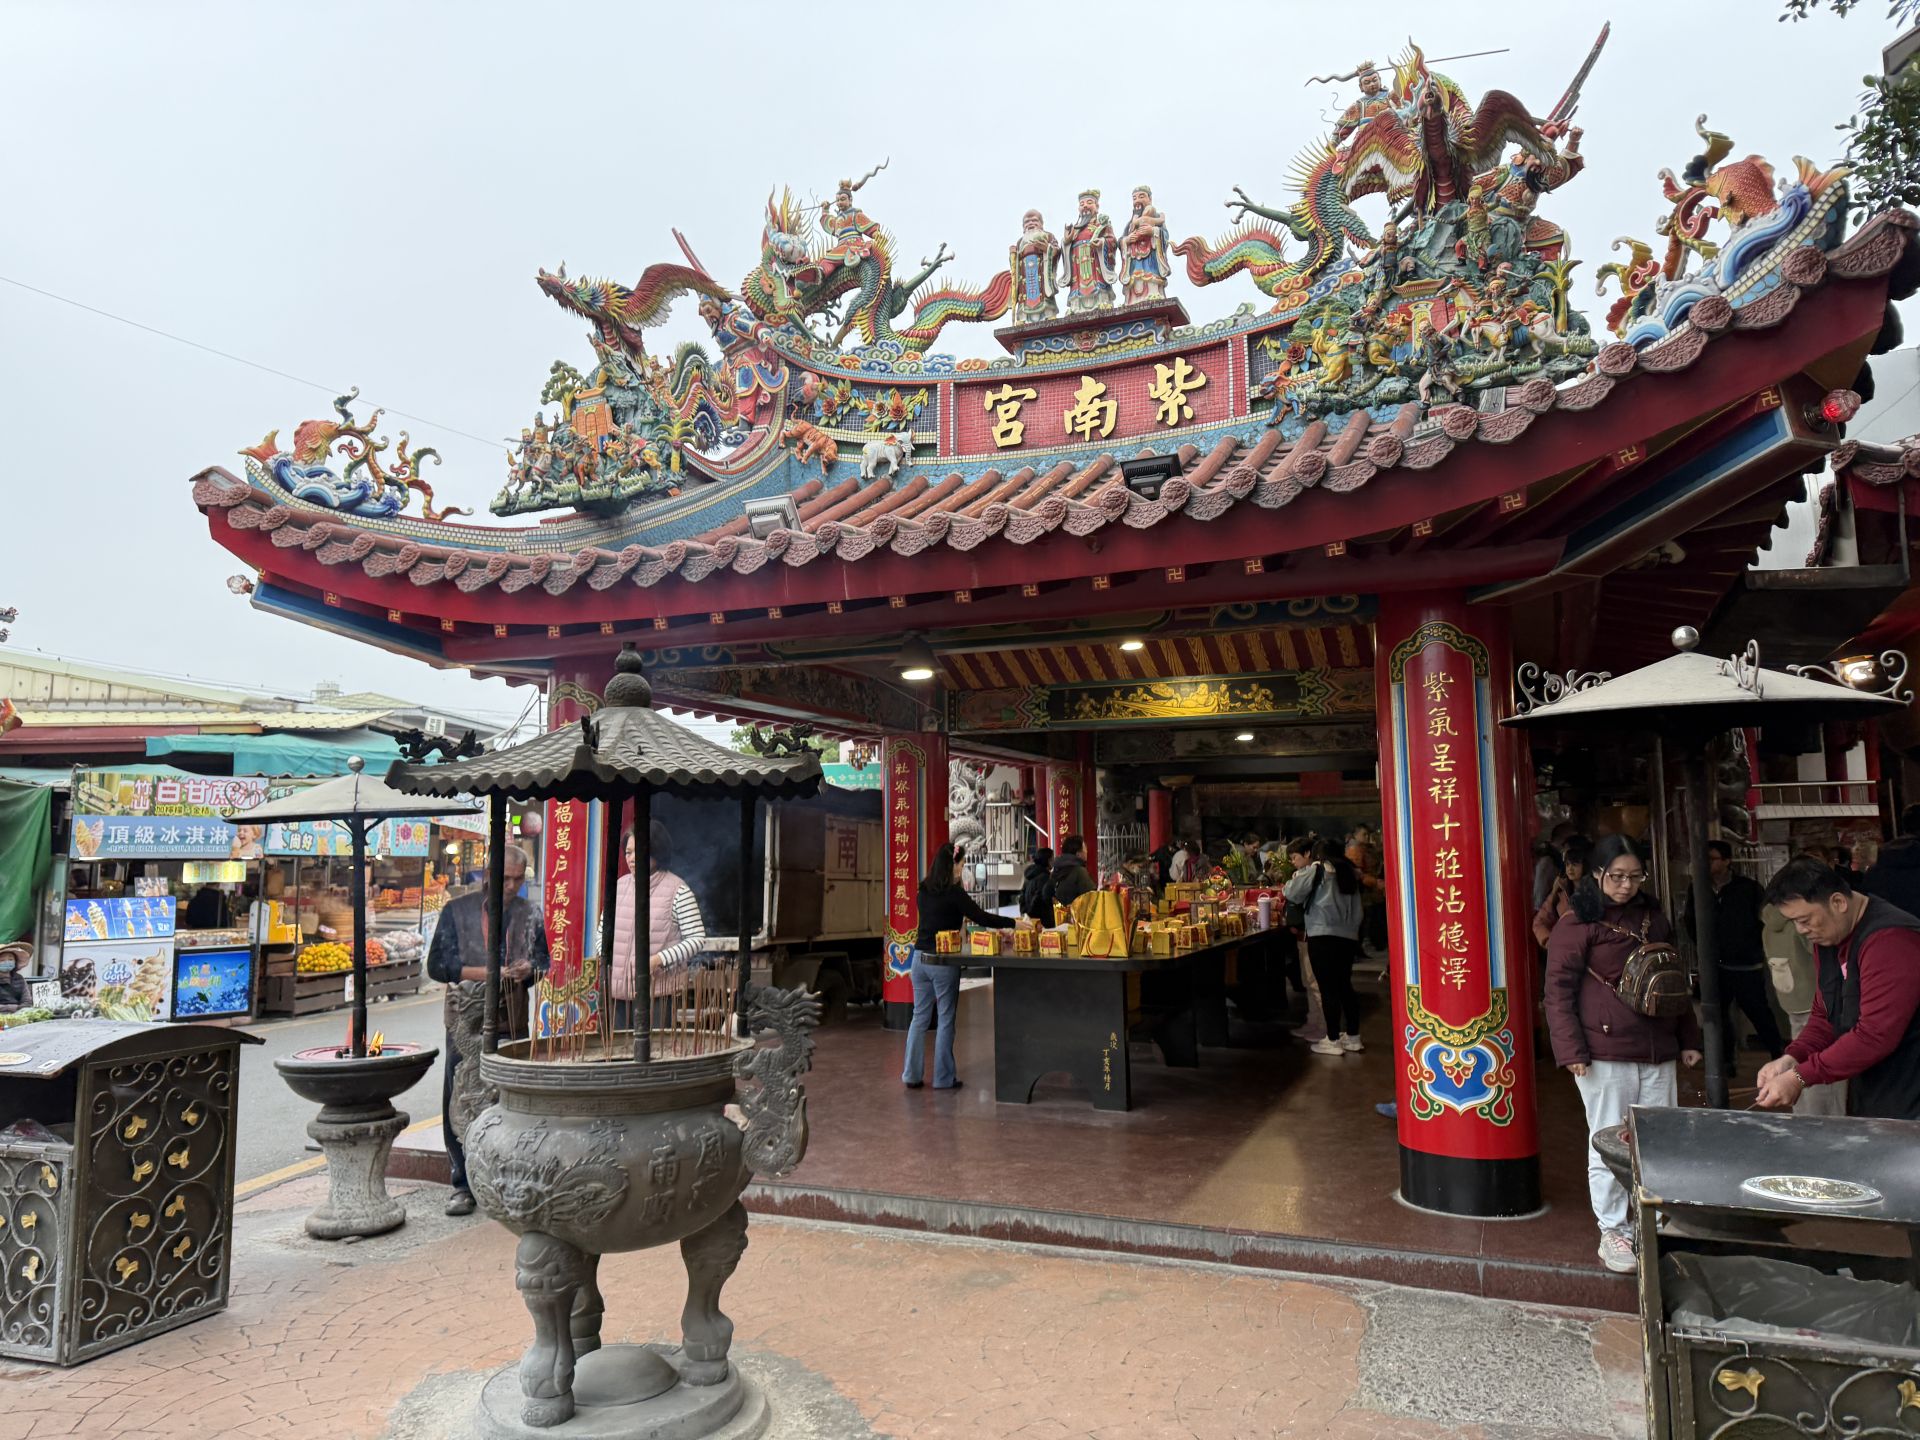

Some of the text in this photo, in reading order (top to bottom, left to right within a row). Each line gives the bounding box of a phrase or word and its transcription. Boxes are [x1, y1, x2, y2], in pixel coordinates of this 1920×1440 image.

[984, 357, 1207, 448] 紫南宮
[108, 825, 230, 845] 頂級冰淇淋
[156, 778, 264, 807] 白甘蔗汁
[1422, 671, 1472, 991] 紫氣呈祥十莊沾德澤
[549, 802, 574, 963] 福萬戶薦馨香
